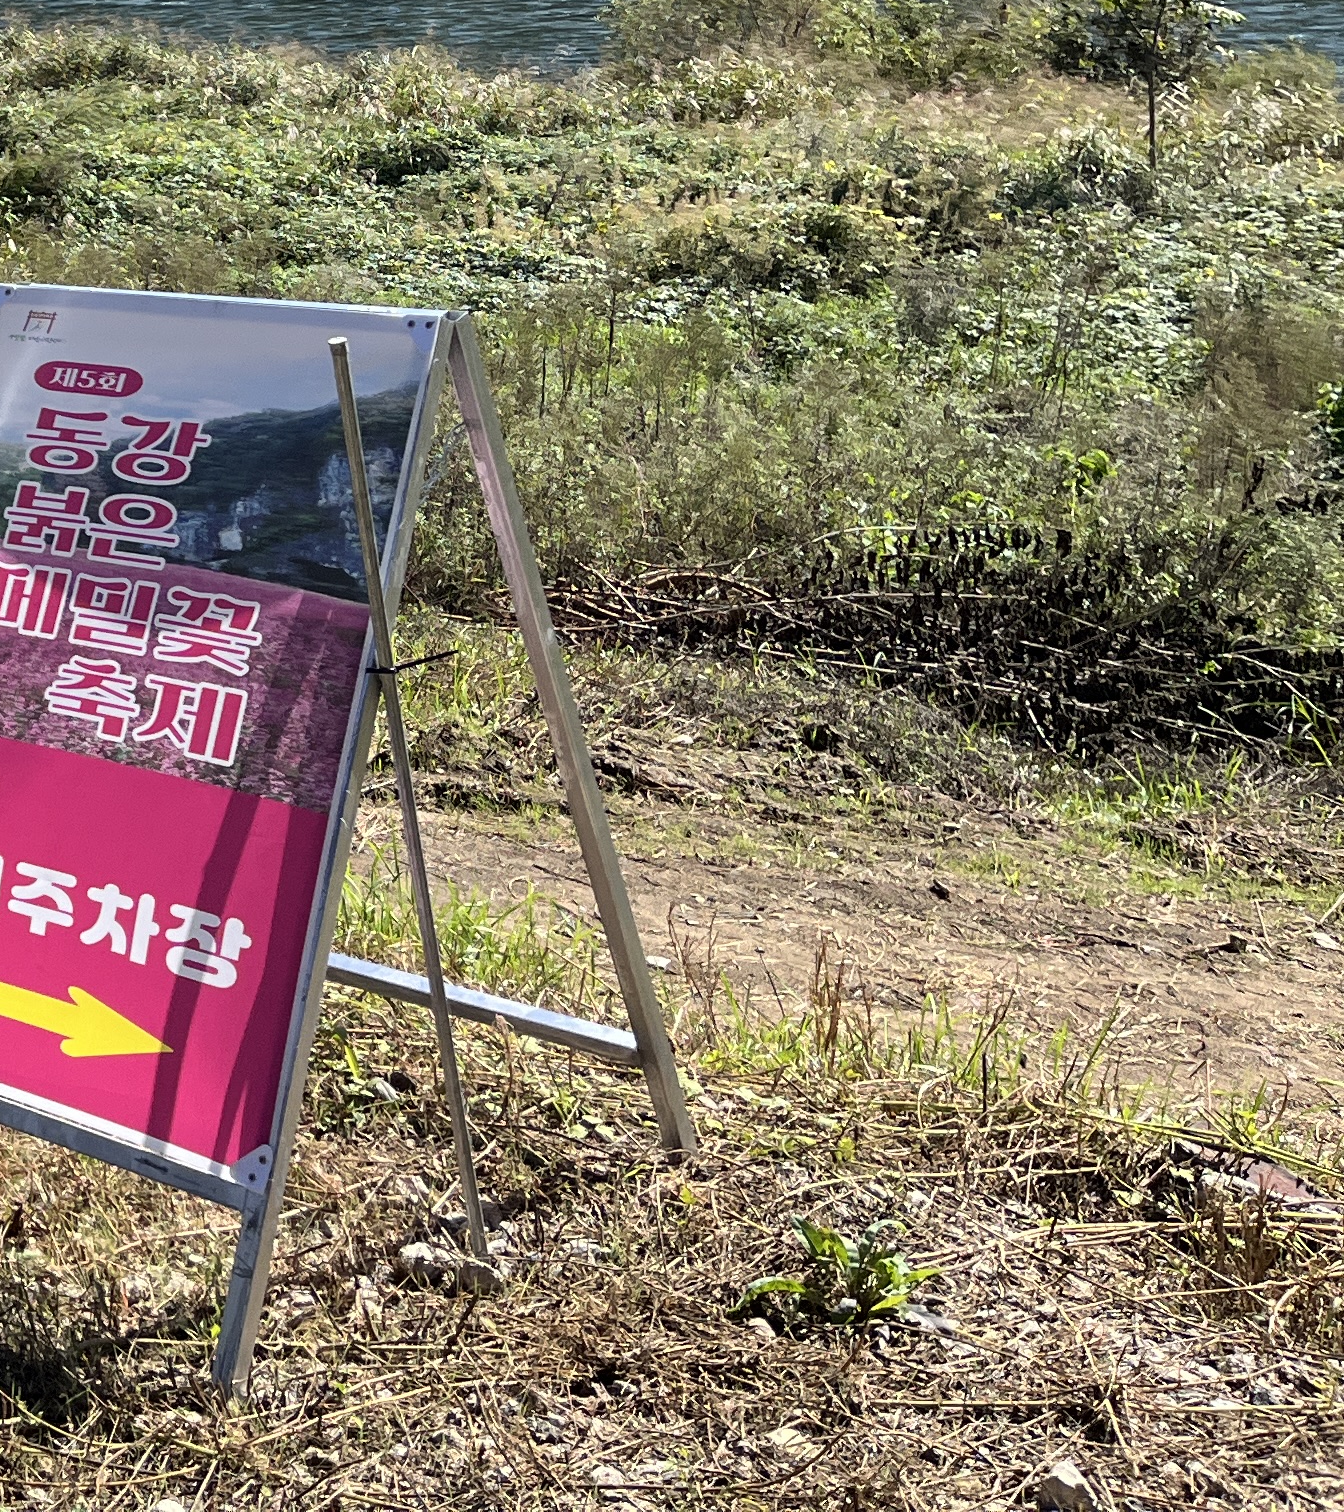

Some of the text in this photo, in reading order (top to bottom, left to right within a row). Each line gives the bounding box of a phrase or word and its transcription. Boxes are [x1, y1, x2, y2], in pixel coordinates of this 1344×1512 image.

[48, 366, 127, 393] 제5회
[23, 405, 211, 486] 동강
[3, 480, 179, 570] 붉은
[45, 655, 248, 767] 축제
